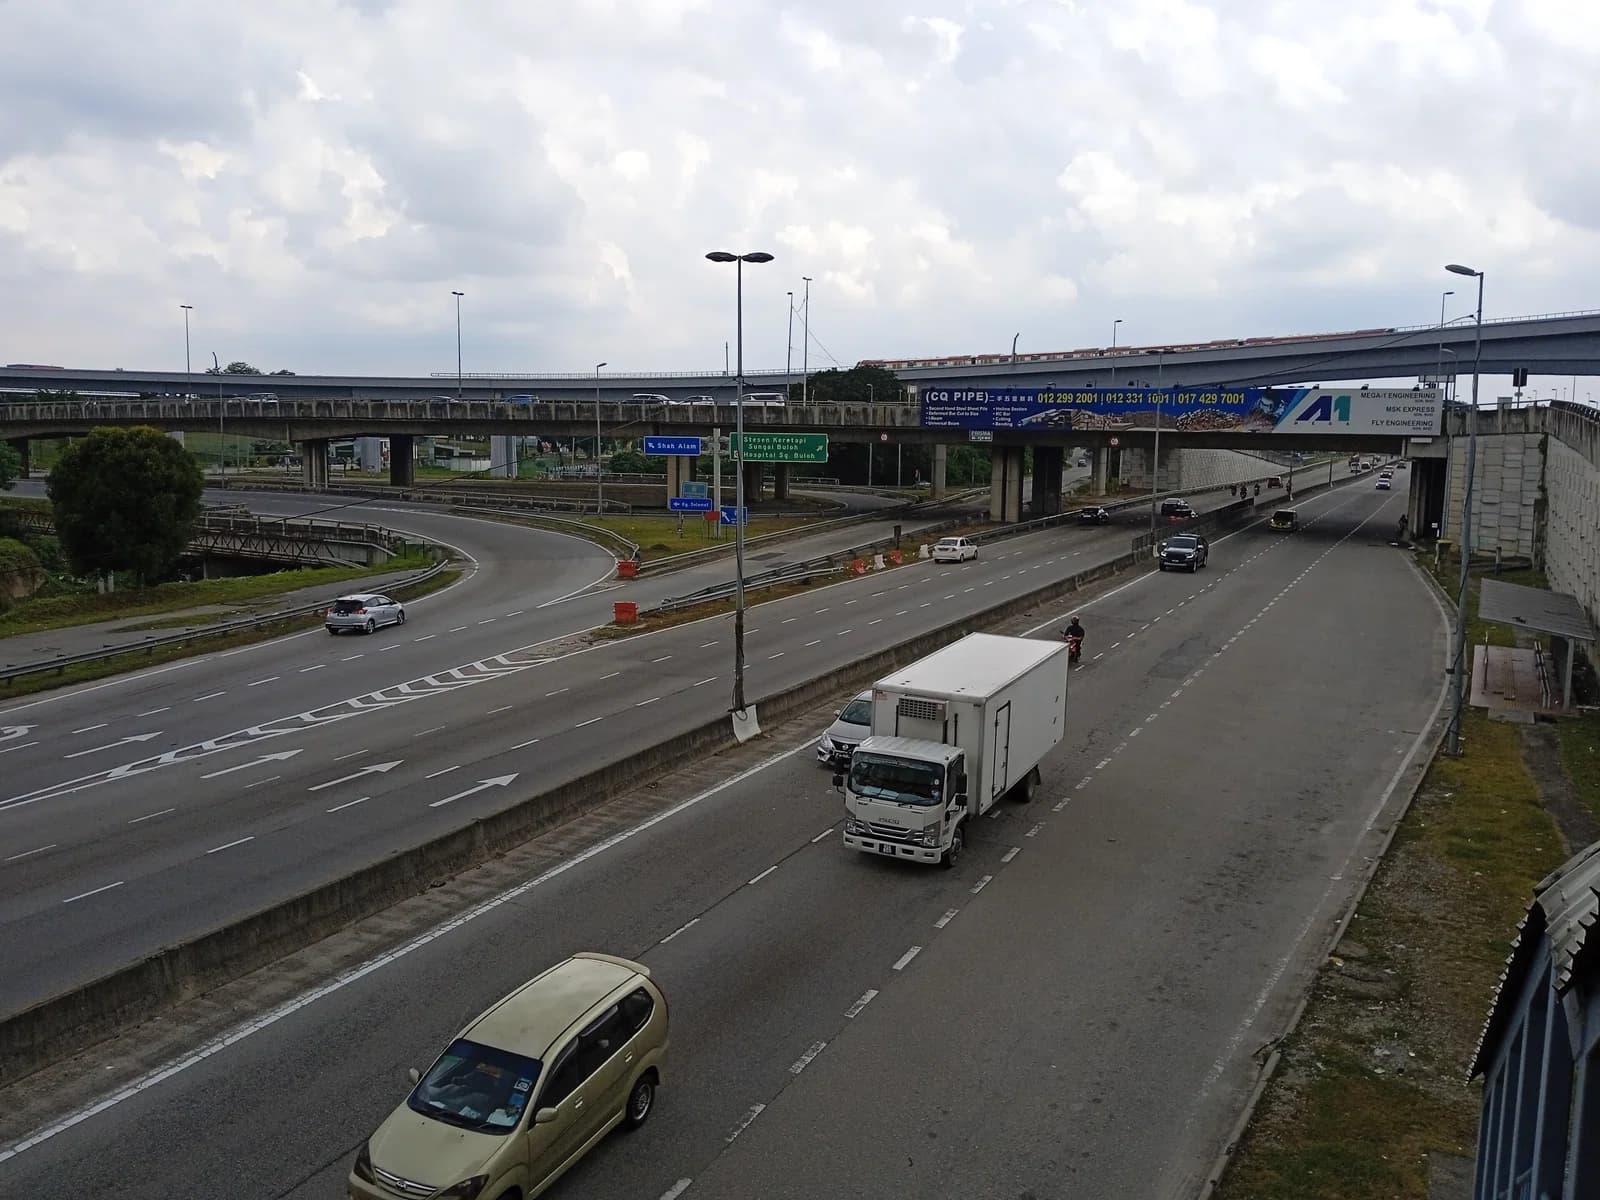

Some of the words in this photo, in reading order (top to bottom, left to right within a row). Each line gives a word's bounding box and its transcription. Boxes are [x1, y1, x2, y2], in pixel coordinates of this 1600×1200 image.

[926, 391, 948, 403] (CQ
[953, 391, 989, 403] PIPE)
[1038, 393, 1054, 403] 012
[1056, 393, 1074, 403] 299
[1076, 393, 1098, 403] 2001
[1106, 393, 1123, 403] 012
[1126, 393, 1143, 403] 331
[1147, 393, 1169, 403] 1001
[1178, 393, 1197, 404] 017
[1199, 393, 1218, 404] 429
[1220, 393, 1245, 404] 7001
